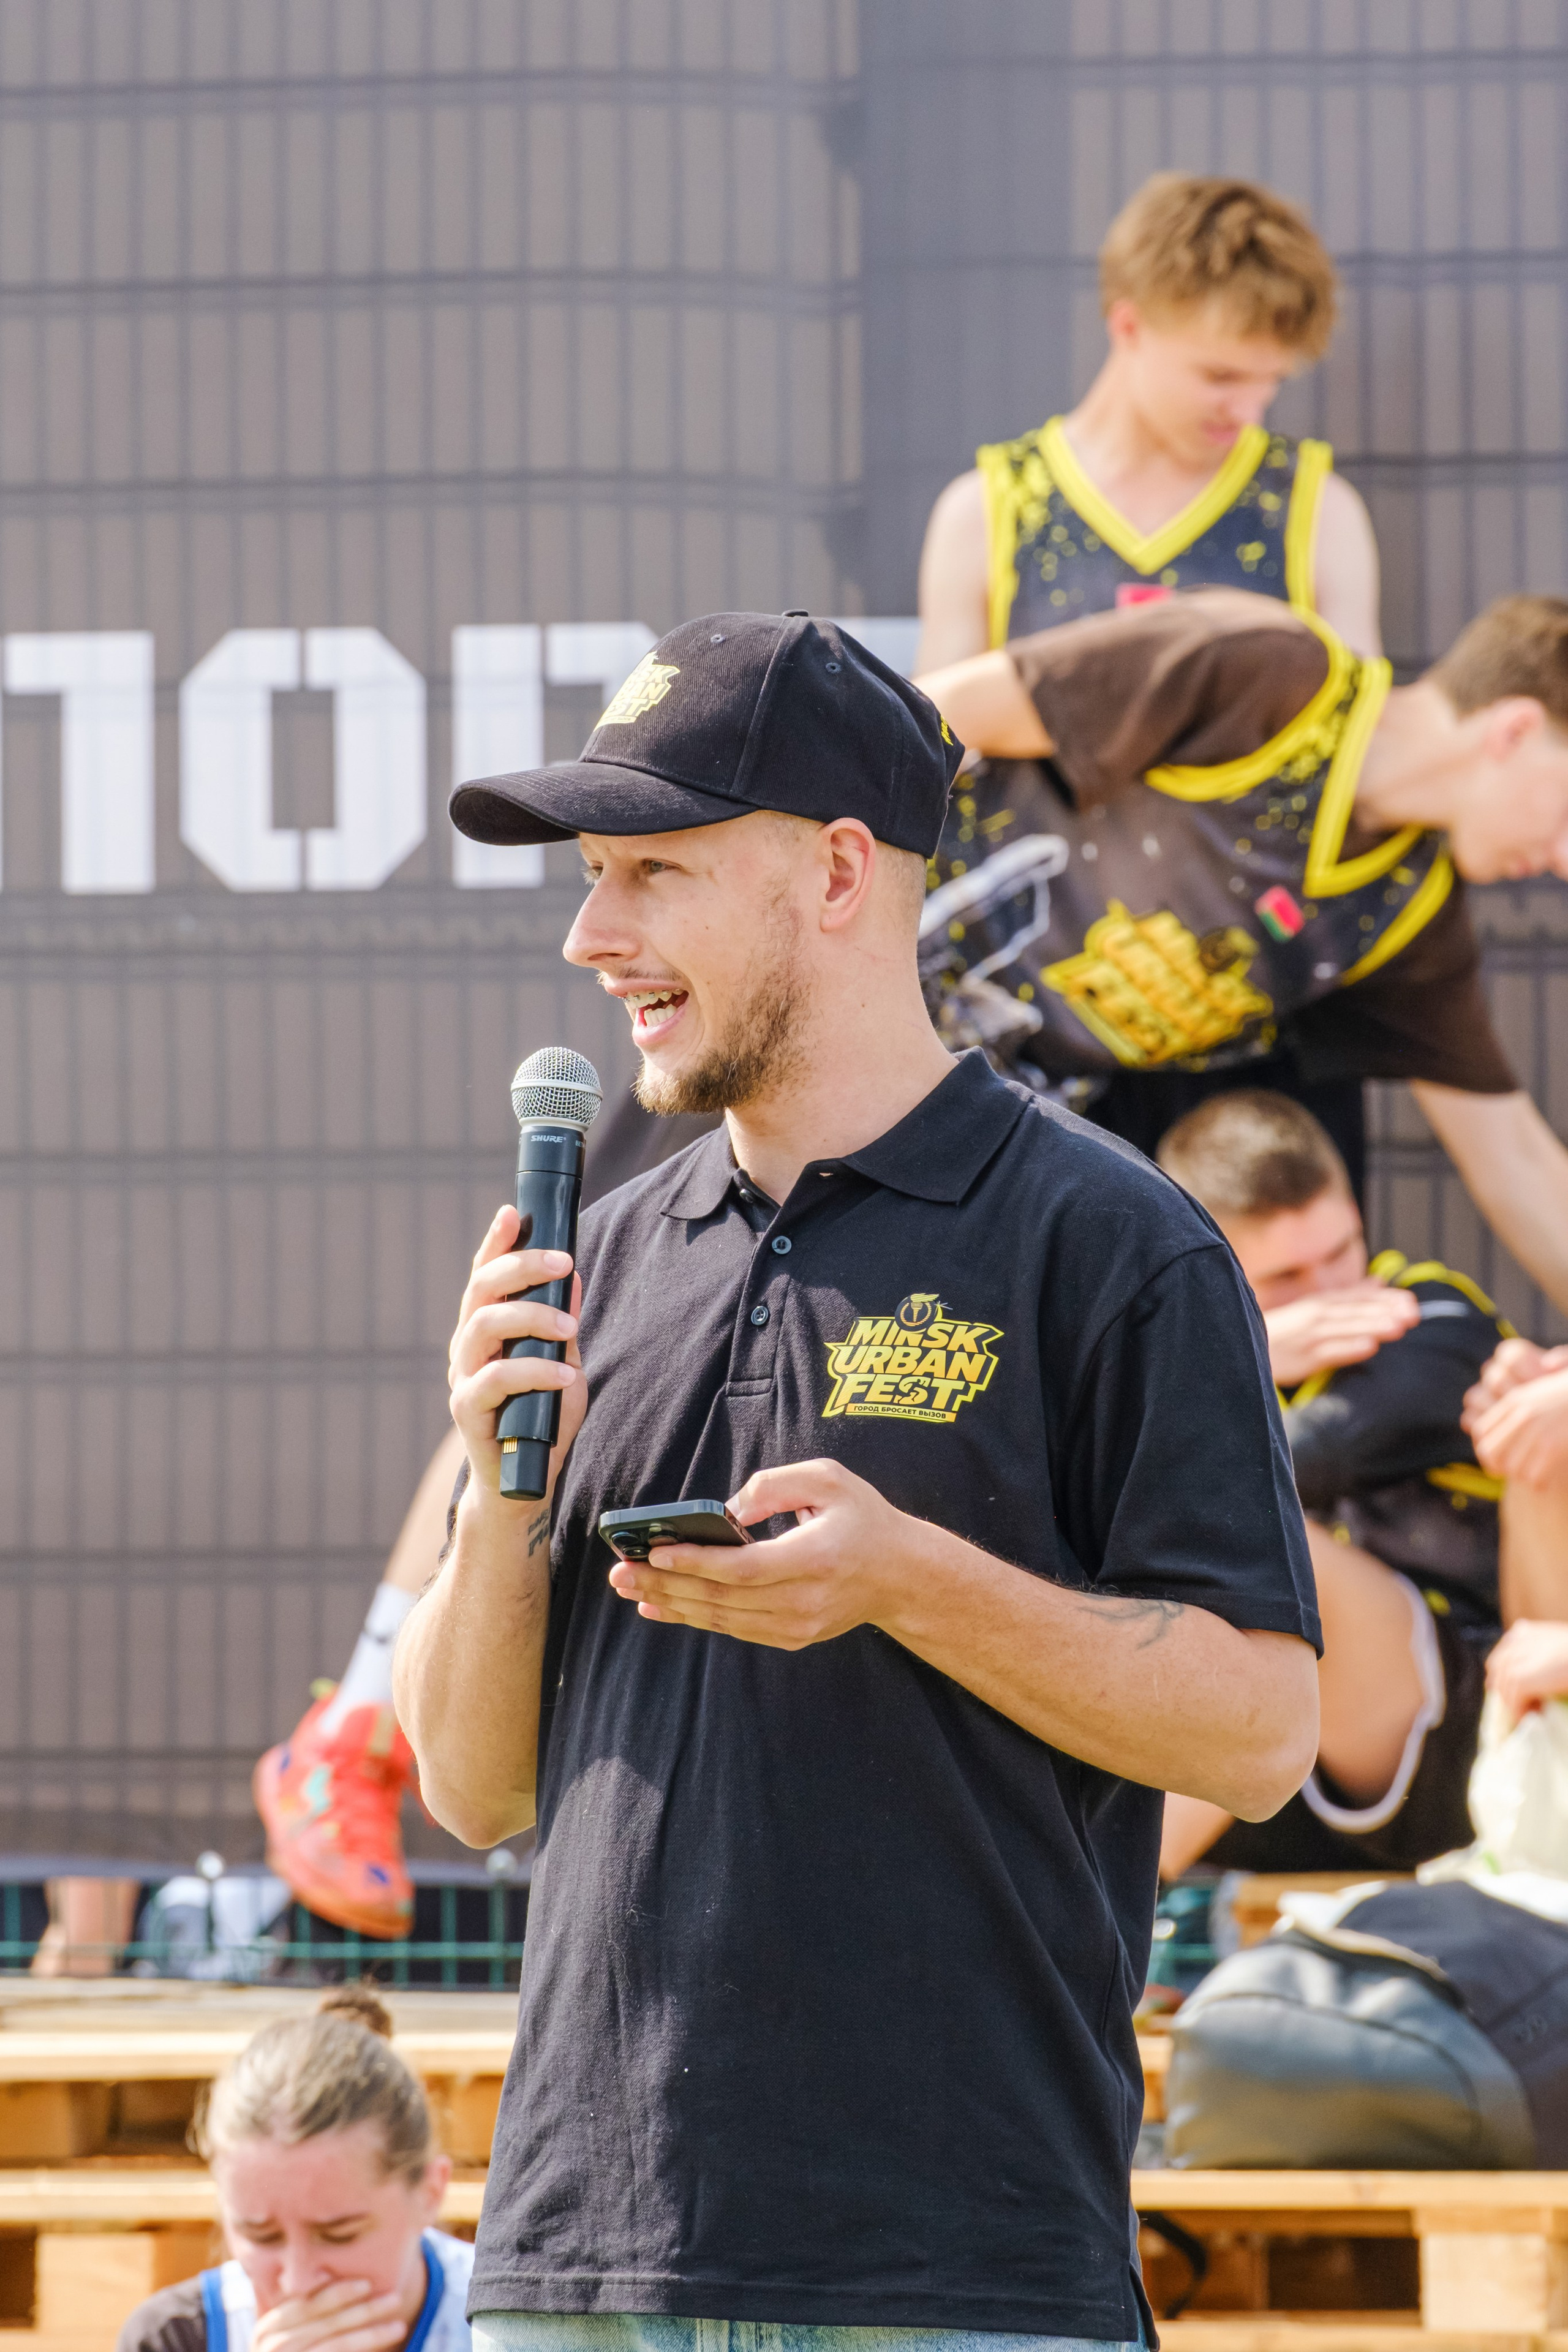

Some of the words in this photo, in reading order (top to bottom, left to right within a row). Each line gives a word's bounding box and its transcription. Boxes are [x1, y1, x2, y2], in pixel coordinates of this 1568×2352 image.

[530, 1135, 564, 1144] SHURE
[849, 1319, 990, 1353] MINSK
[834, 1345, 987, 1382] URBAN
[834, 1373, 966, 1409] FEST
[919, 1410, 946, 1419] ВЫЗОВ
